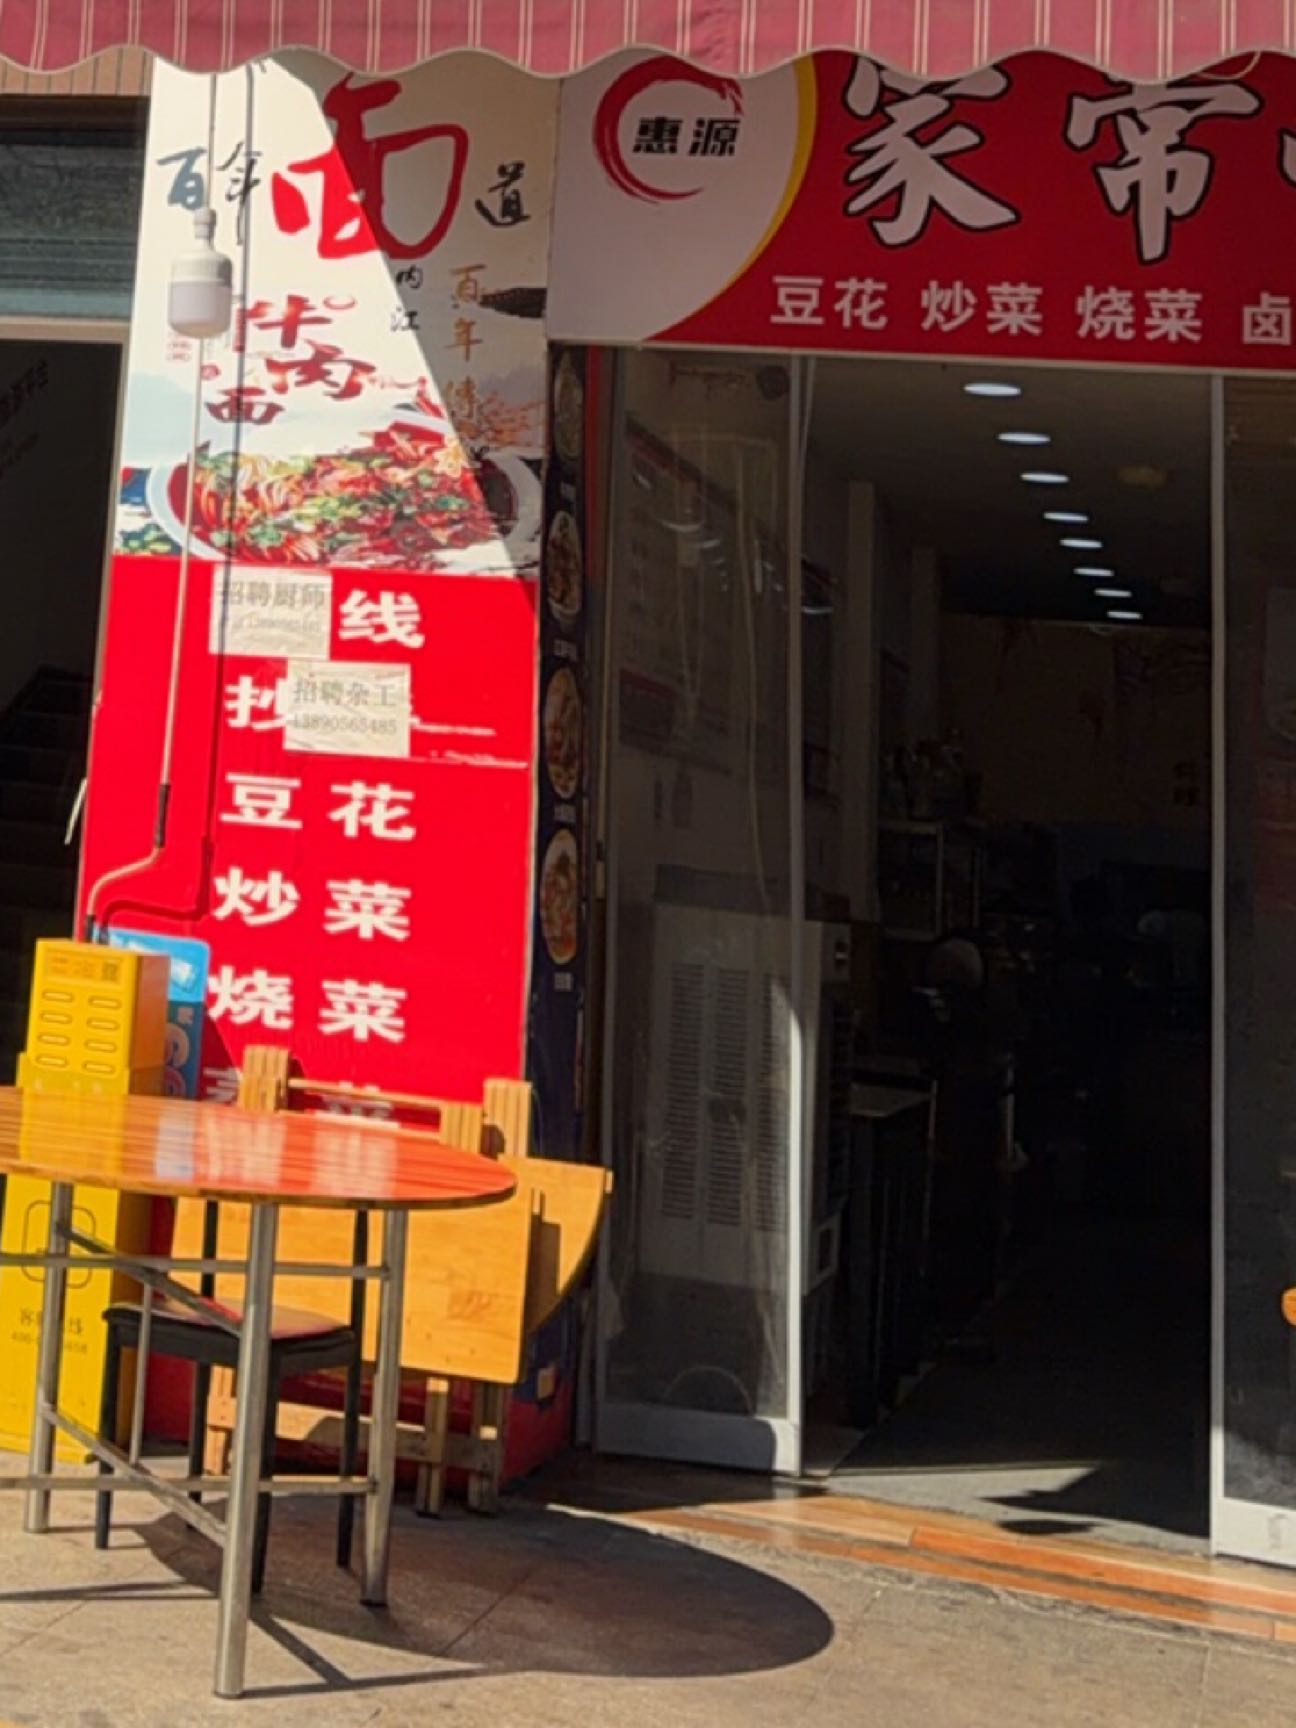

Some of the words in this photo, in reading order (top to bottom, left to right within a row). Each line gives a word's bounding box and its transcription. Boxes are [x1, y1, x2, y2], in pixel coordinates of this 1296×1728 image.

[632, 116, 741, 158] 惠源
[842, 54, 1296, 265] 家常
[770, 275, 888, 330] 豆花
[919, 280, 1044, 337] 炒菜
[1075, 285, 1203, 343] 烧菜
[1242, 292, 1292, 346] 卤
[204, 294, 377, 424] 牛肉面
[339, 588, 425, 649] 线
[294, 675, 398, 708] 招聘杂工
[220, 772, 417, 842] 豆花
[213, 866, 411, 942] 炒菜
[206, 964, 407, 1044] 烧菜
